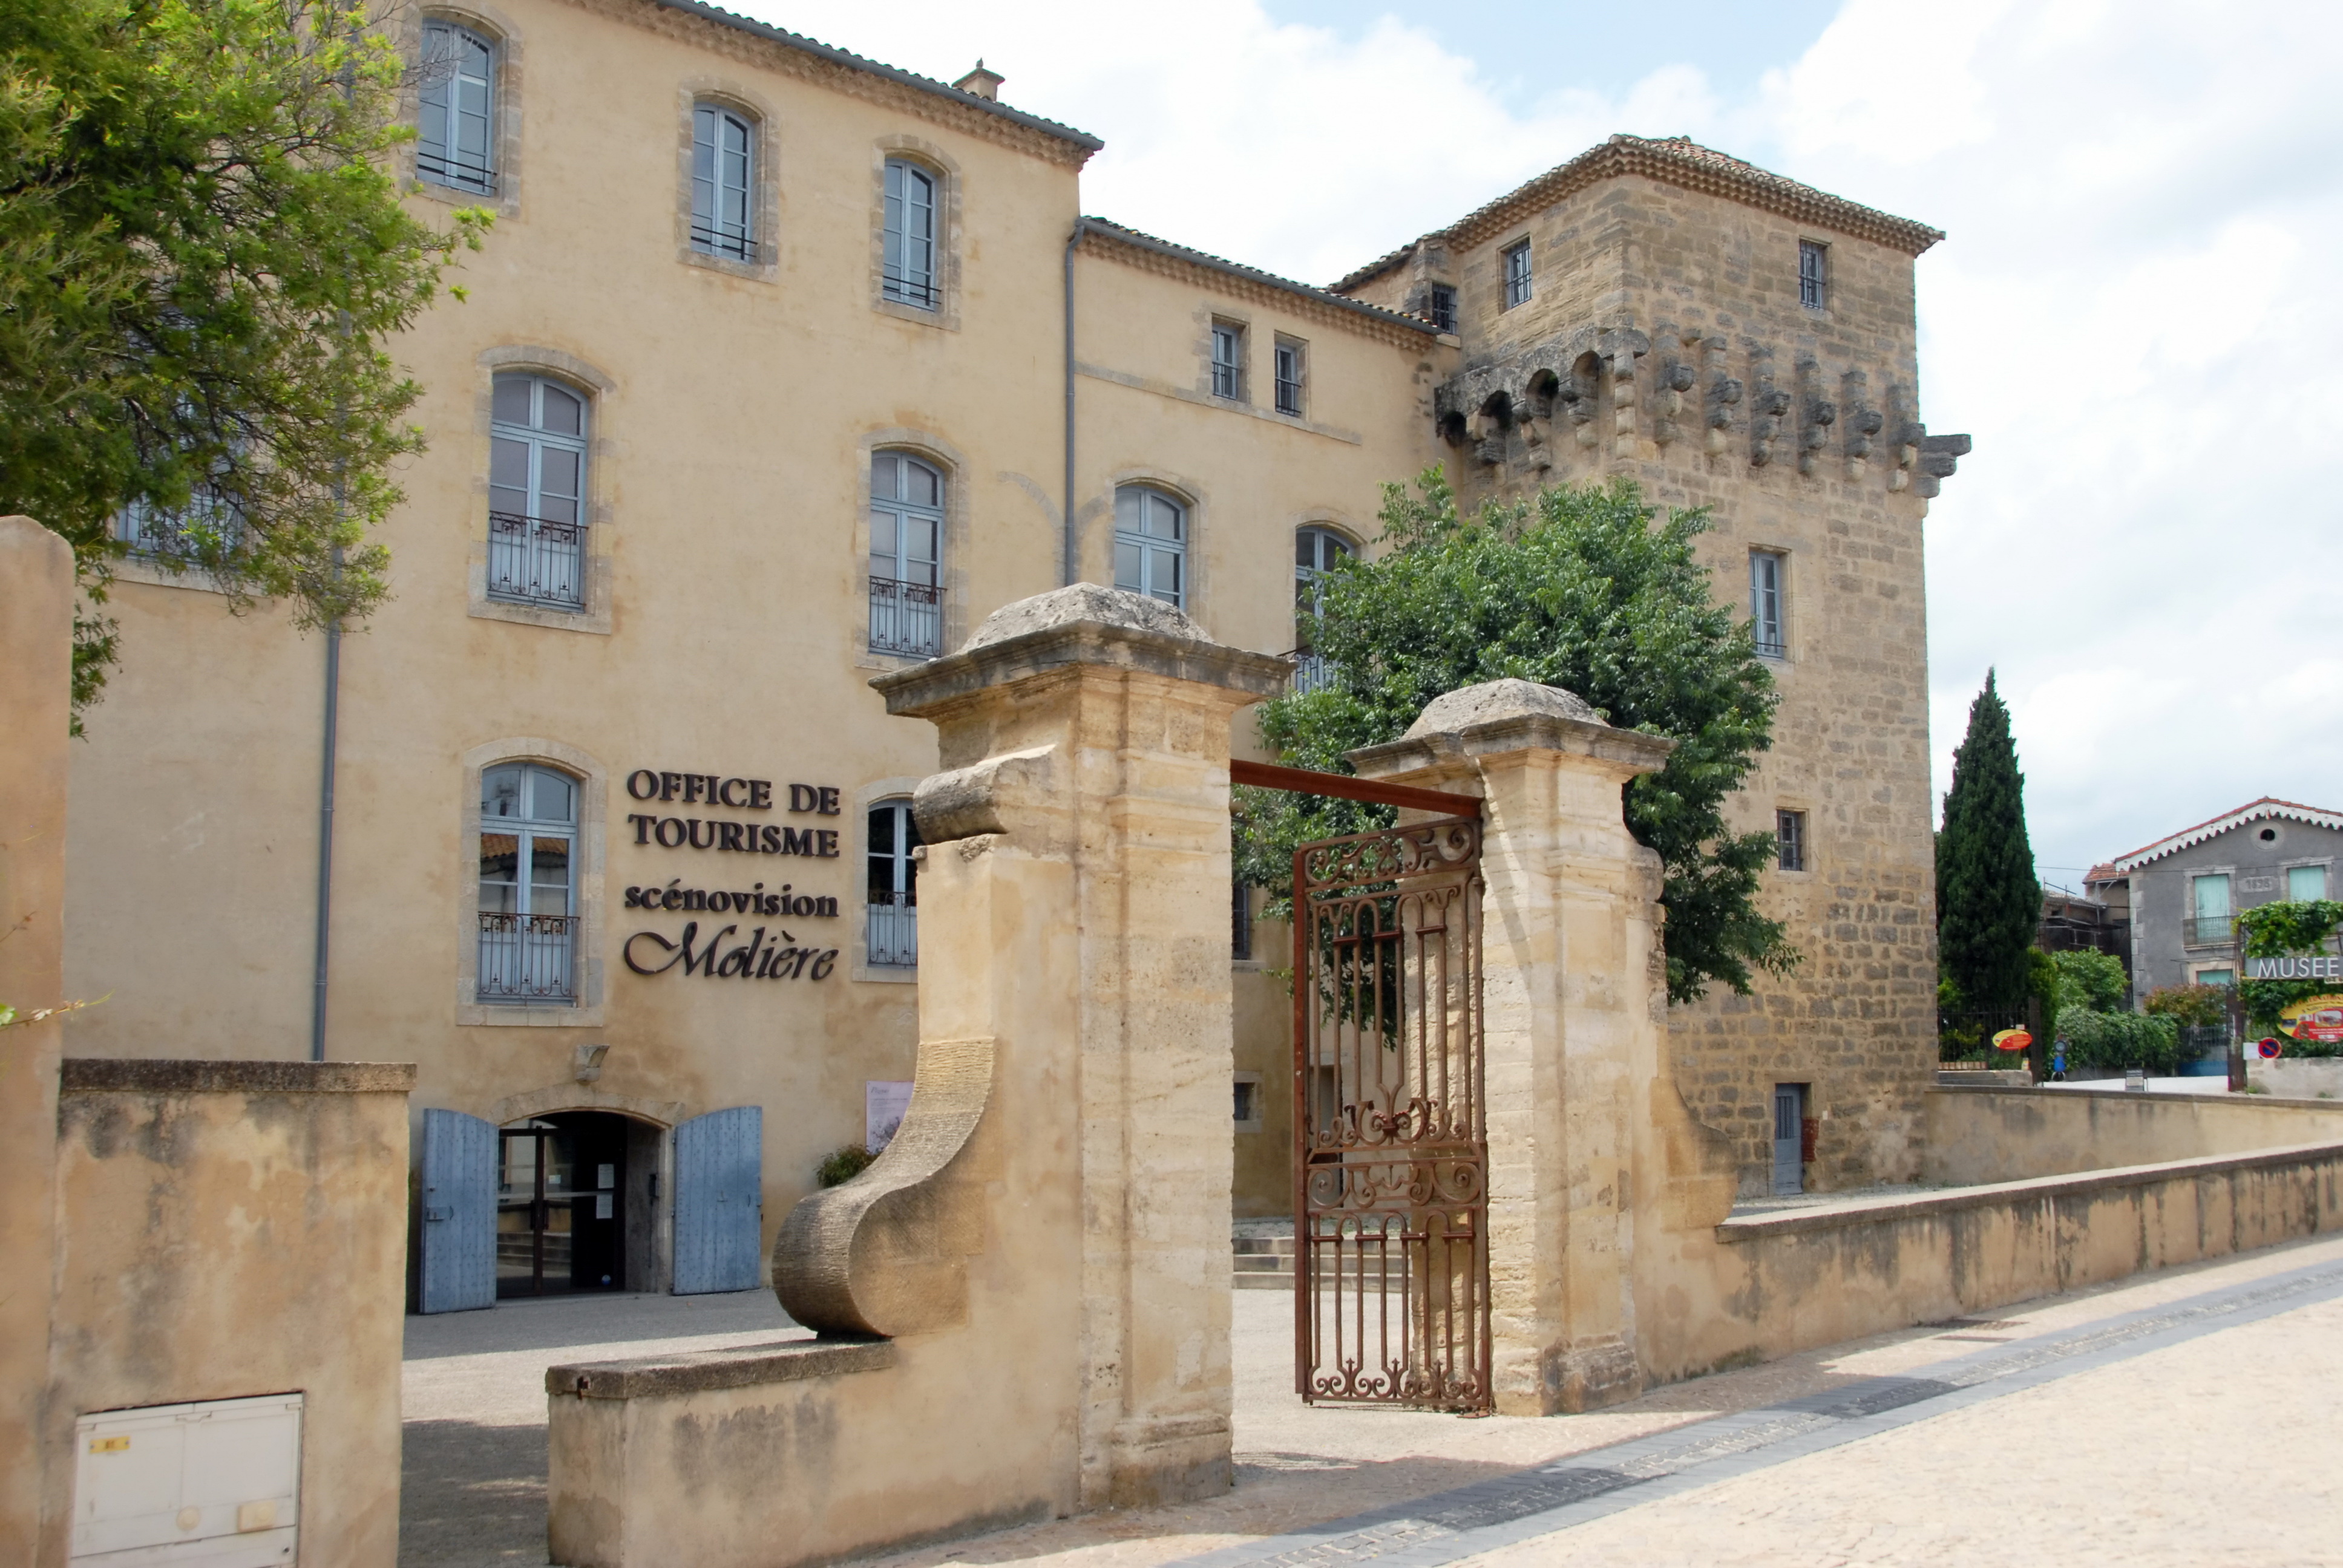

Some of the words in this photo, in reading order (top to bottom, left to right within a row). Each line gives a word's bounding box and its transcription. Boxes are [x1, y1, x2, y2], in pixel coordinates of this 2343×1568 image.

[627, 769, 772, 809] OFFICE
[788, 783, 841, 815] DE
[628, 814, 840, 858] TOURISME
[624, 878, 839, 917] scénovision
[623, 921, 839, 981] Molière
[2257, 958, 2339, 978] MUSEE
